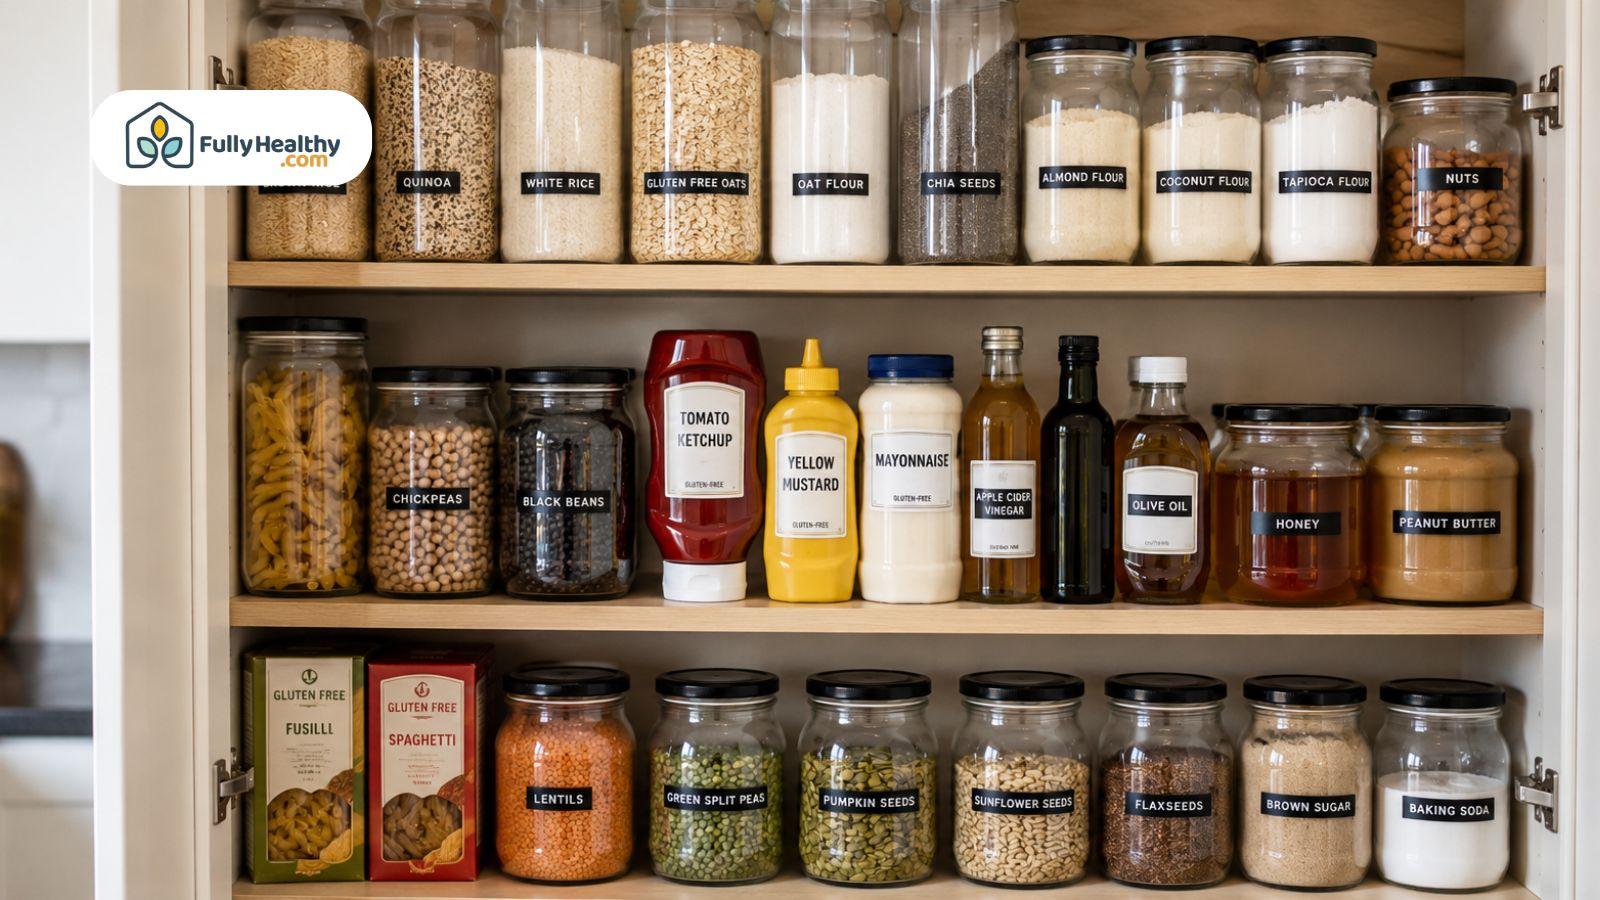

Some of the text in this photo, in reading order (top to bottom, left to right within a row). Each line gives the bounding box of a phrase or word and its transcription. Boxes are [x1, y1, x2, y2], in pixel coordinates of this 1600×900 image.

[403, 176, 451, 189] QUINOA
[526, 178, 595, 190] WHITE RICE
[646, 177, 747, 190] GLUTEN FREE OATS
[927, 178, 996, 189] CHIA SEEDS
[1042, 172, 1125, 184] ALMOND FLOUR
[1159, 176, 1250, 188] COCONUT FLOUR
[1283, 177, 1370, 188] TAPIOCA FLOUR
[1445, 173, 1480, 185] NUTS
[797, 179, 864, 190] OAT FLOUR
[680, 411, 730, 426] TOMATO
[677, 433, 733, 448] KETCHUP
[788, 456, 835, 470] YELLOW
[875, 453, 949, 468] MAYONNAISE
[783, 478, 839, 492] MUSTARD
[393, 494, 463, 505] CHICKPEAS
[523, 497, 605, 507] BLACK BEANS
[976, 492, 1032, 503] APPLE CIDER
[984, 506, 1025, 516] VINEGAR
[1132, 500, 1188, 512] OLIVE OIL
[1276, 518, 1321, 530] HONEY
[1399, 516, 1497, 530] PEANUT BUTTER
[273, 690, 346, 701] GLUTEN FREE
[387, 702, 457, 713] GLUTEN FREE
[389, 733, 456, 747] SPAGHETTI
[533, 794, 584, 805] LENTILS
[666, 792, 766, 806] GREEN SPLIT PEAS
[823, 796, 916, 808] PUMPKIN SEEDS
[974, 795, 1073, 809] SUNFLOWER SEEDS
[1135, 799, 1204, 812] FLAXSEEDS
[1266, 799, 1351, 813] BROWN SUGAR
[1409, 803, 1490, 816] BAKING SODA
